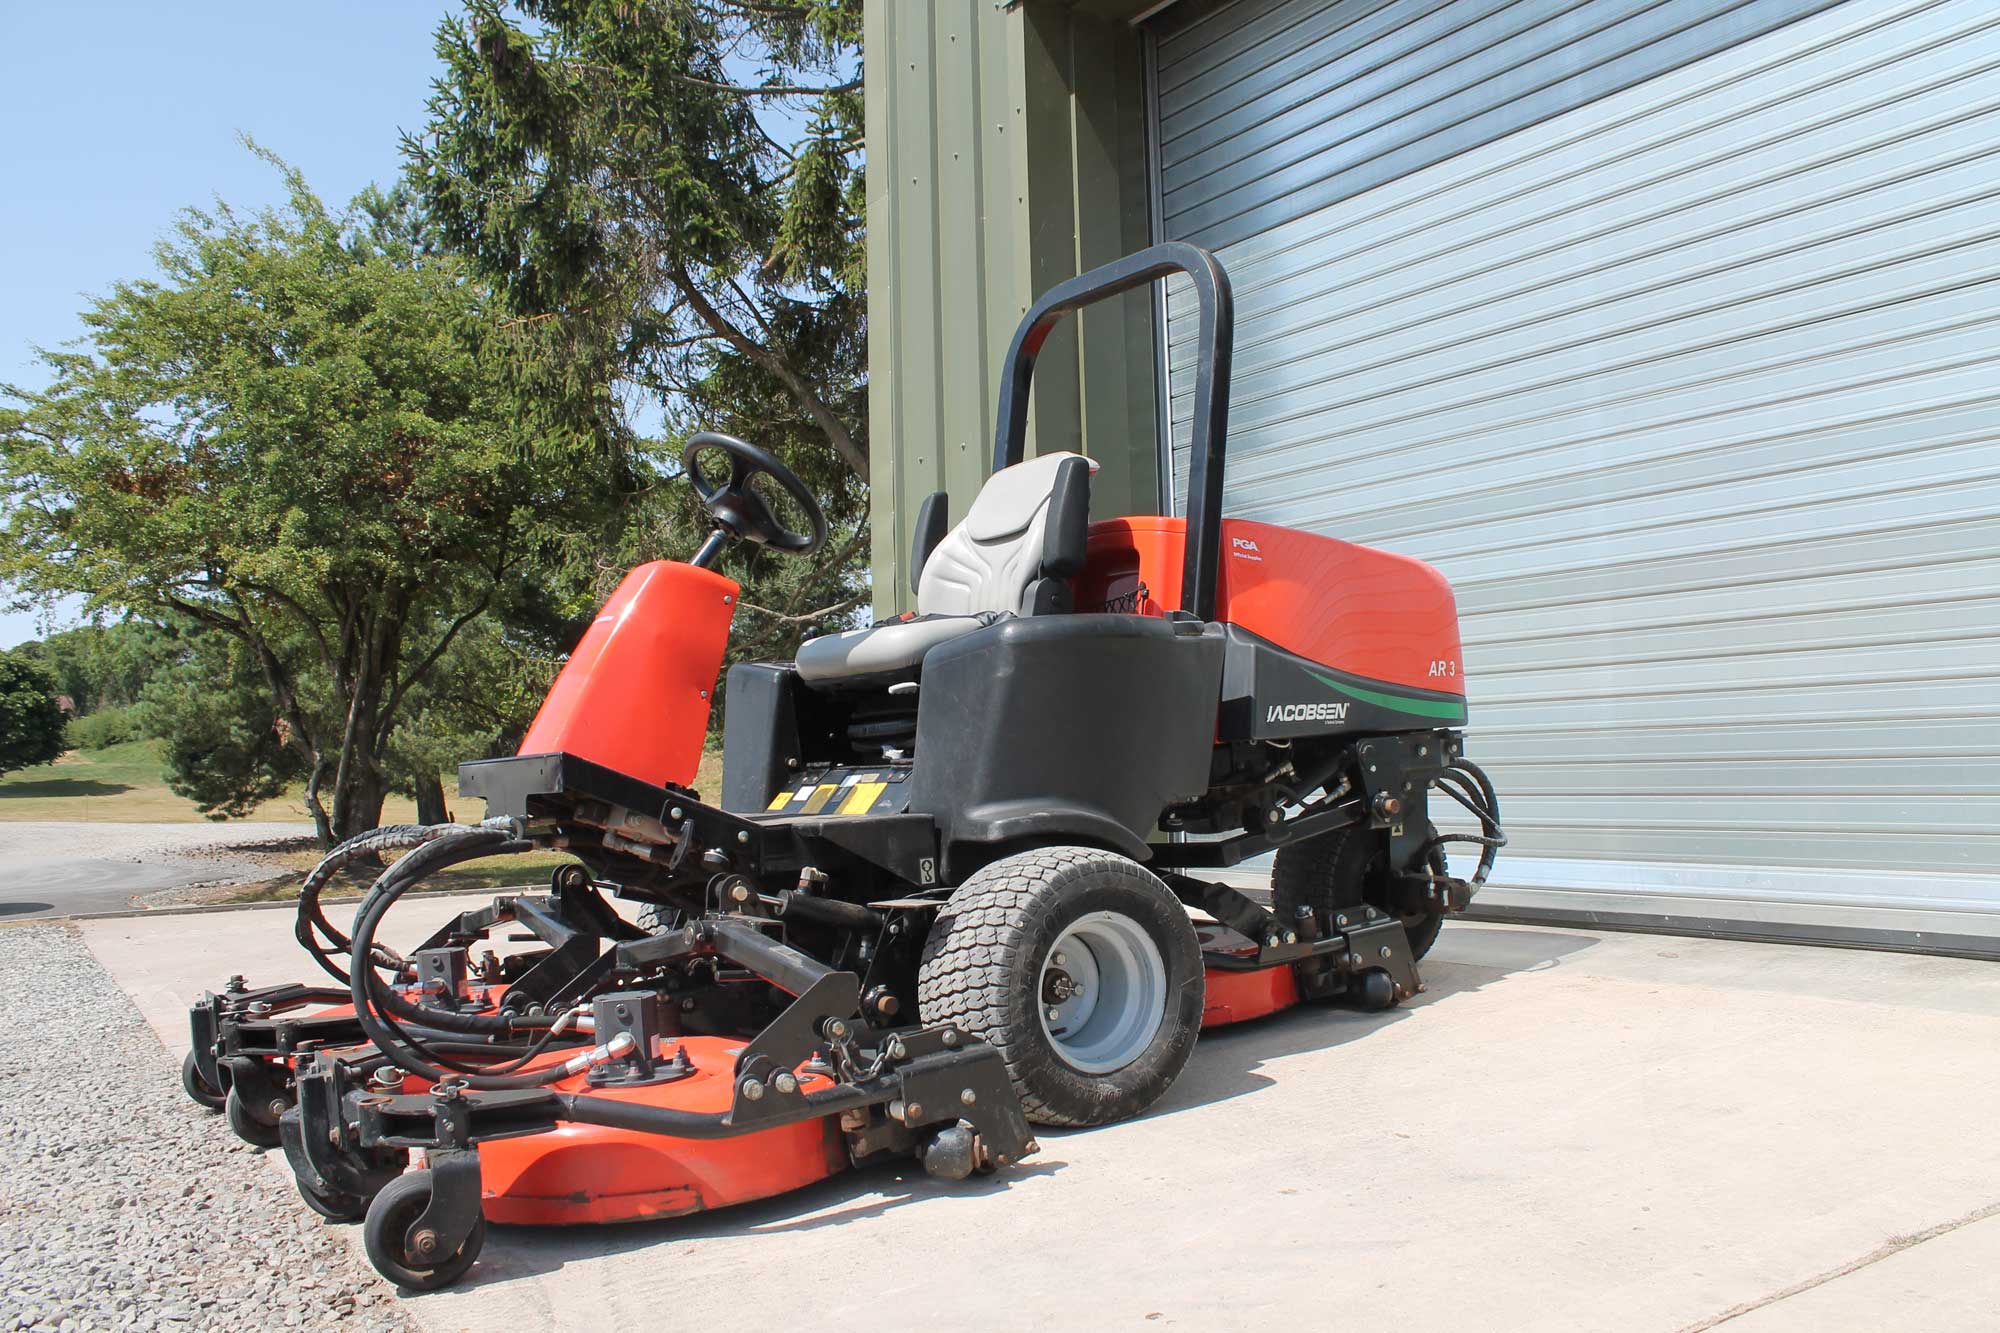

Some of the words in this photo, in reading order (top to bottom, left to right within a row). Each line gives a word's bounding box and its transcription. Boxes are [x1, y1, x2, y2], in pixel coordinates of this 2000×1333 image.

[1232, 537, 1259, 551] PGA
[1428, 660, 1447, 677] AR
[1449, 660, 1455, 677] 3
[1266, 702, 1348, 722] JACOBSEN
